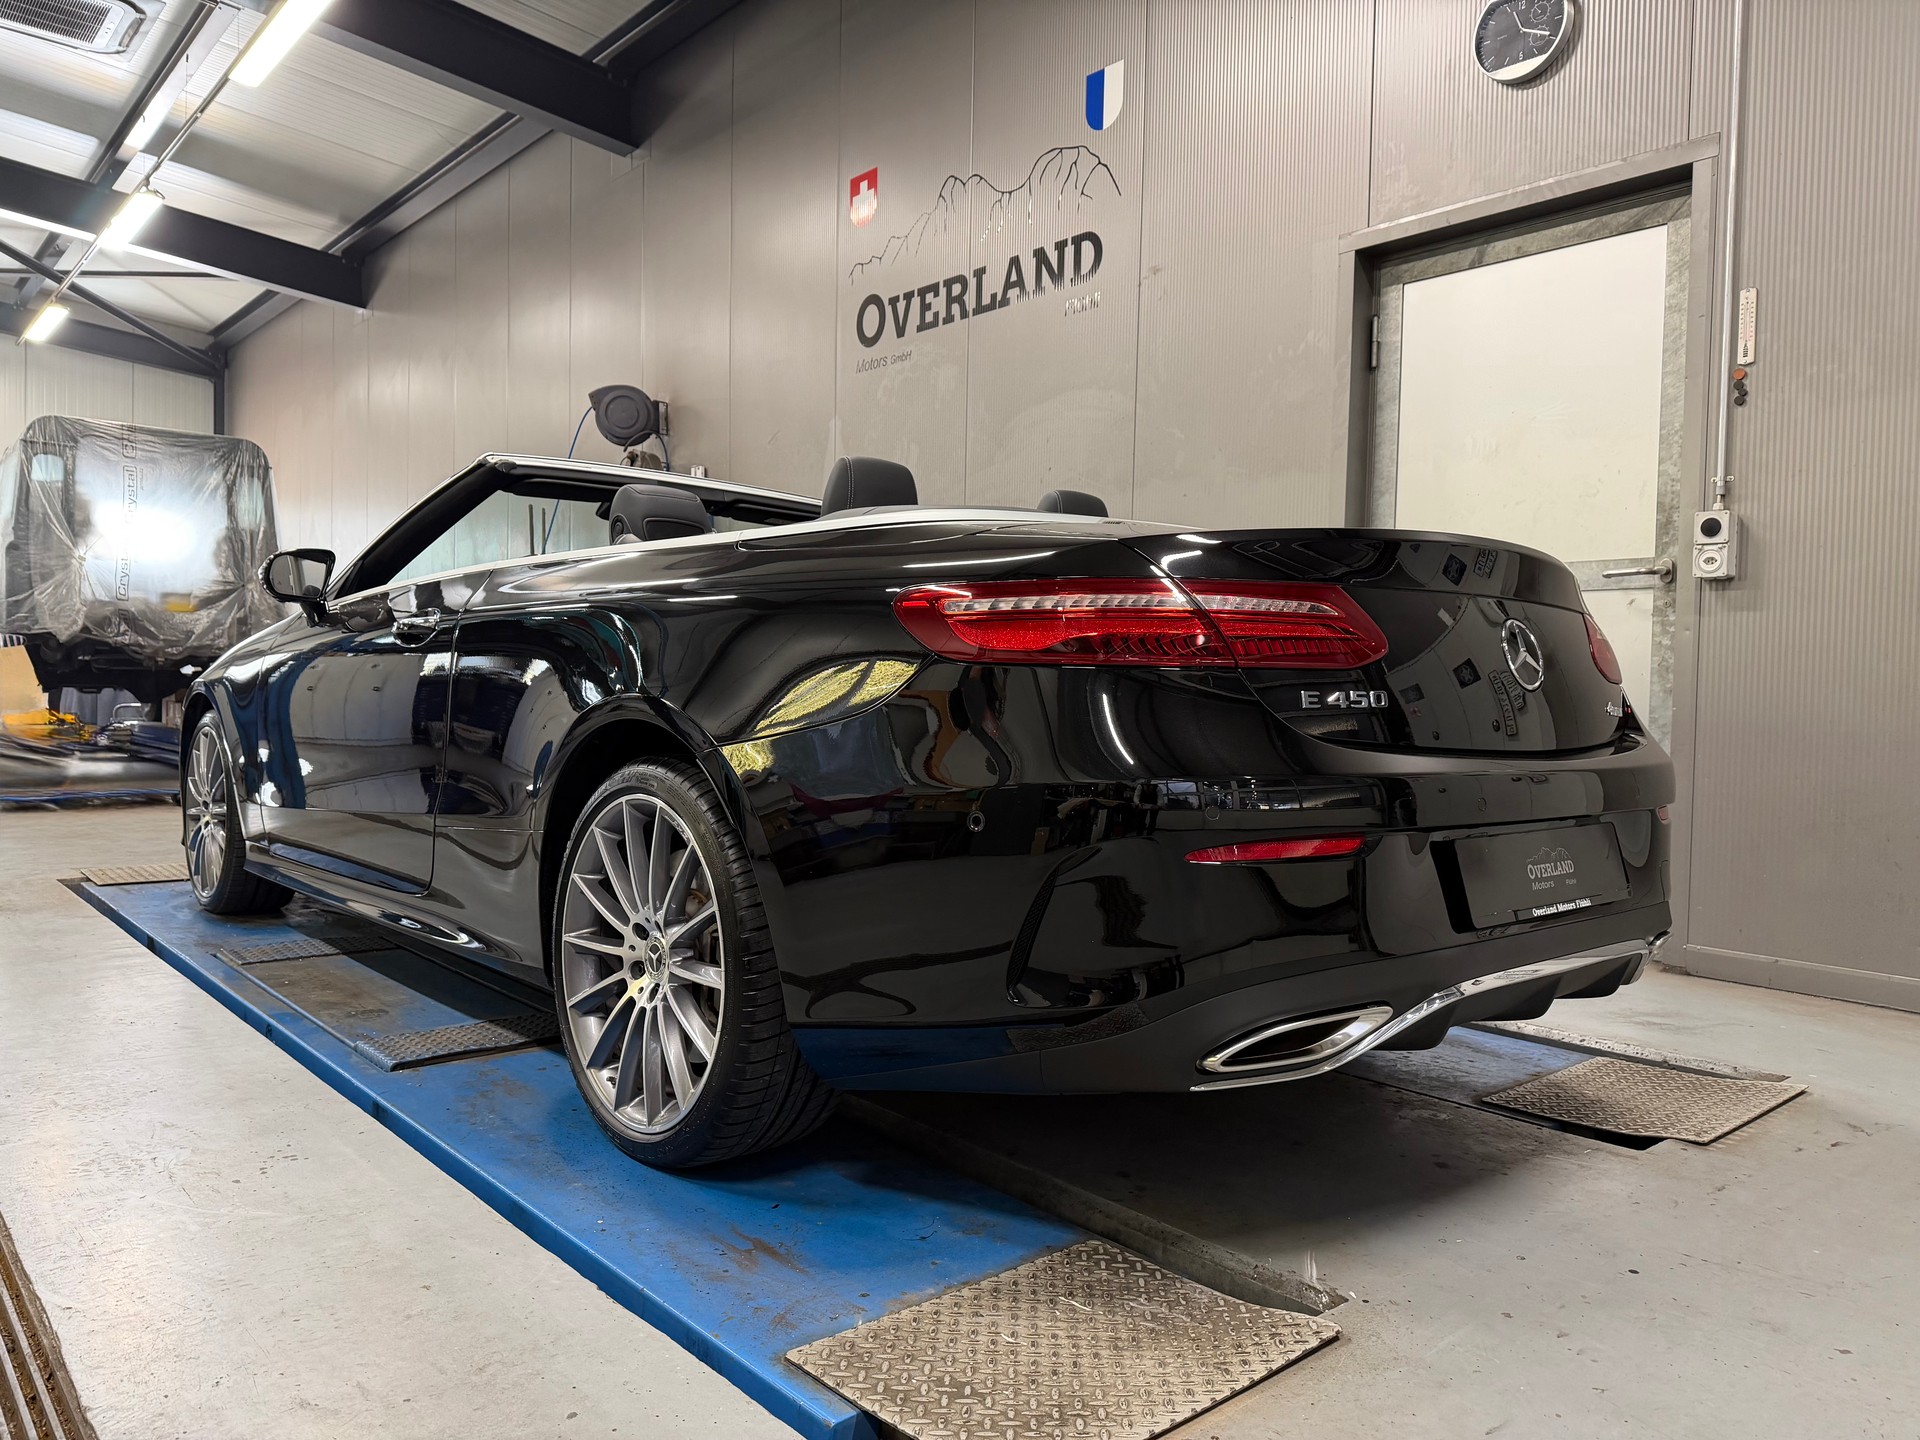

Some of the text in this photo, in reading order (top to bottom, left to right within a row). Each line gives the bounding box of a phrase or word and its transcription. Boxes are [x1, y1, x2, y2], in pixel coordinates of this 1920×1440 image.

[1519, 51, 1524, 60] 6
[856, 231, 1103, 348] OVERLAND
[856, 350, 912, 374] Motors GmbH
[1301, 690, 1388, 708] E 450
[1527, 860, 1574, 879] OVERLAND
[1532, 881, 1554, 890] Motors
[1532, 904, 1557, 916] Overland
[1557, 902, 1575, 911] Motors
